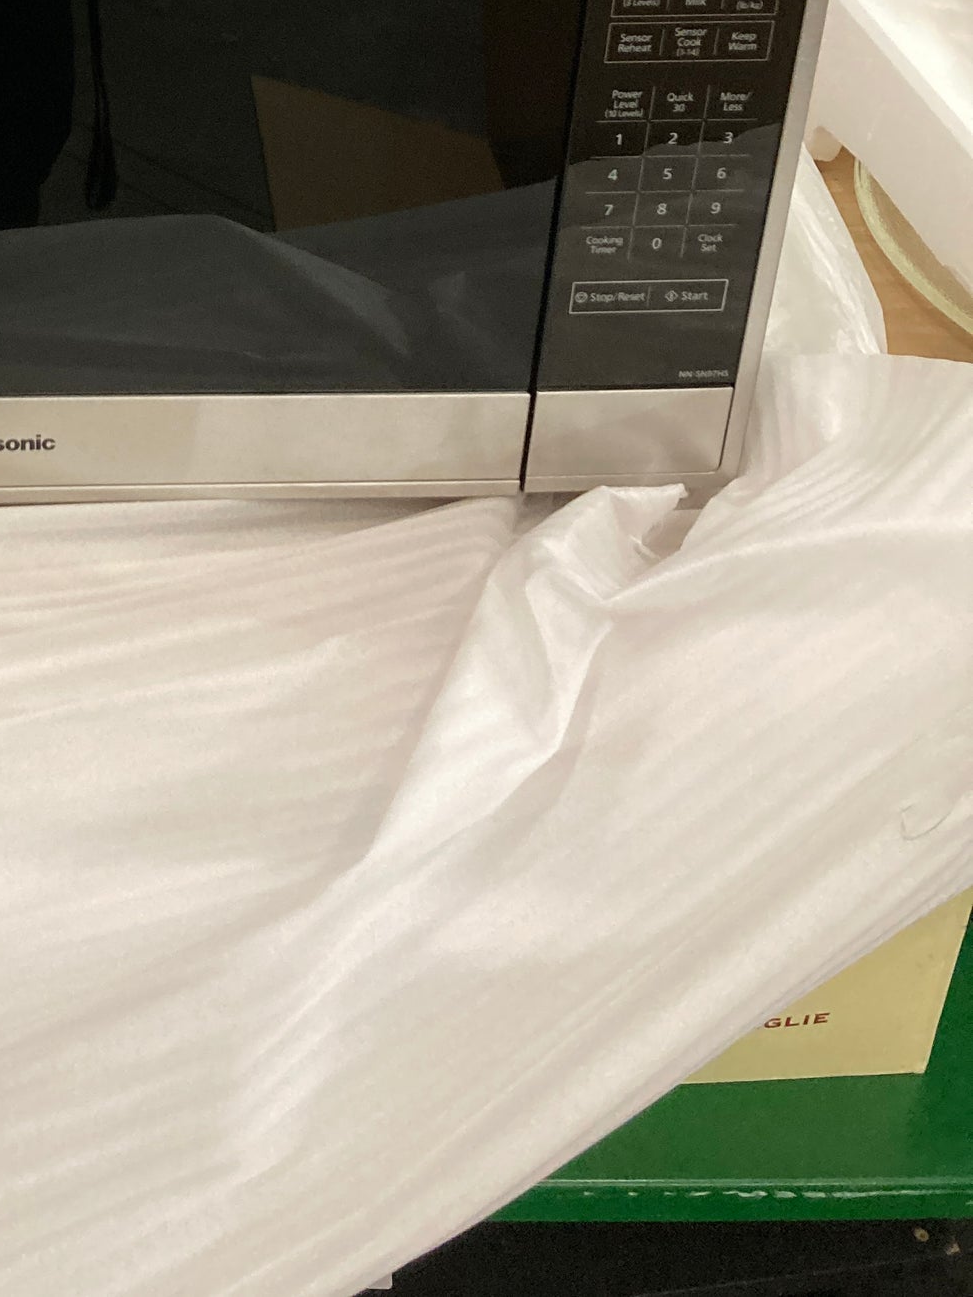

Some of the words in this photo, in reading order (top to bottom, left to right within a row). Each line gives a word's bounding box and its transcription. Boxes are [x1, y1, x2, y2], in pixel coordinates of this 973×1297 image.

[675, 27, 708, 37] Sensor
[731, 32, 757, 42] Keep
[620, 33, 653, 43] Sensor
[677, 37, 702, 48] Cook
[617, 43, 652, 53] Reheat
[728, 42, 757, 51] Warm
[611, 89, 643, 99] Power
[666, 92, 694, 102] Quick
[720, 91, 752, 102] More/
[613, 99, 640, 109] Level
[723, 102, 744, 112] Less
[615, 133, 623, 146] 1
[668, 132, 678, 145] 2
[723, 131, 734, 144] 3
[607, 168, 618, 181] 4
[662, 167, 673, 180] 5
[716, 167, 727, 179] 6
[604, 204, 614, 216] 7
[656, 202, 668, 215] 8
[710, 202, 721, 214] 9
[585, 235, 624, 246] Cooking
[651, 237, 662, 250] 0
[697, 233, 723, 243] Clock
[590, 245, 617, 254] Timer
[700, 243, 717, 253] Set
[590, 292, 646, 303] Stop/Reset
[681, 290, 709, 302] Start
[757, 1012, 831, 1029] GLIE
